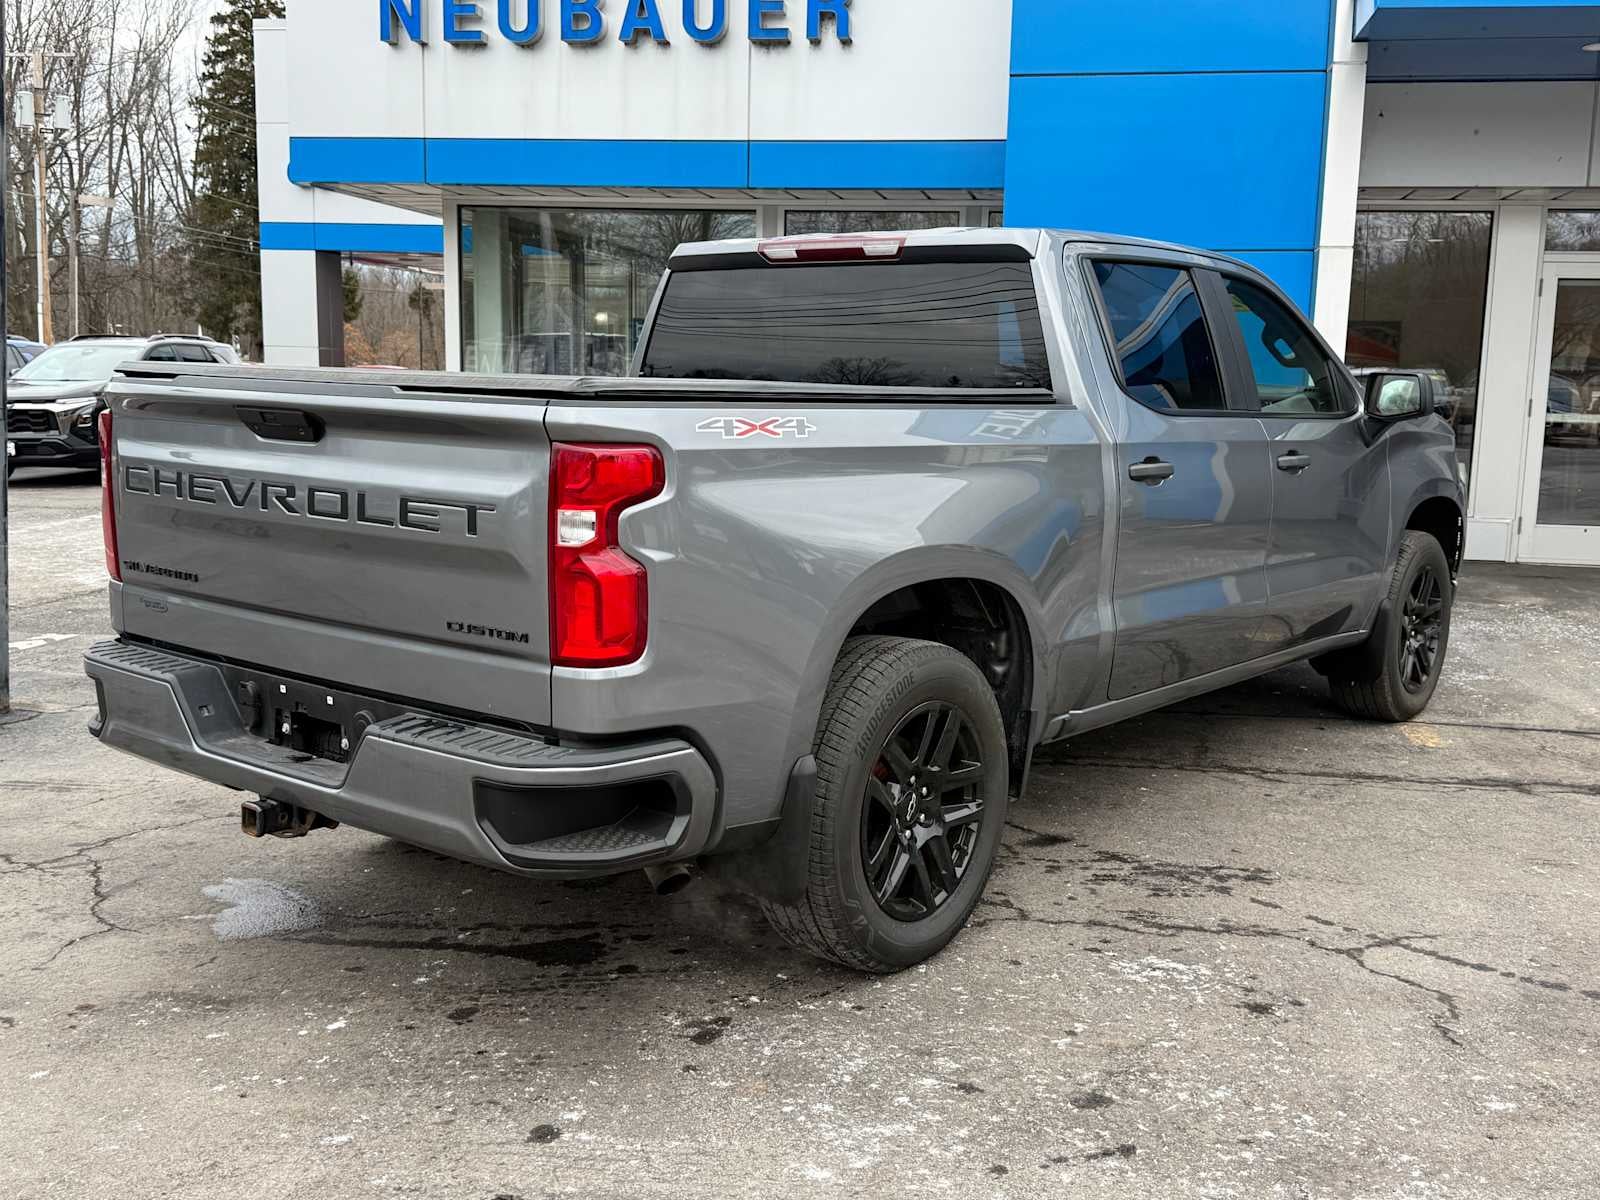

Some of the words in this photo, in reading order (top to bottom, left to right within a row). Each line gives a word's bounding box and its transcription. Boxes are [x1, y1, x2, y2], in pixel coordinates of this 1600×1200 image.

[380, 0, 855, 46] NEUBAUER
[124, 465, 497, 537] CHEVROLET
[123, 560, 199, 583] SILVERADO
[446, 621, 529, 644] CUSTOM
